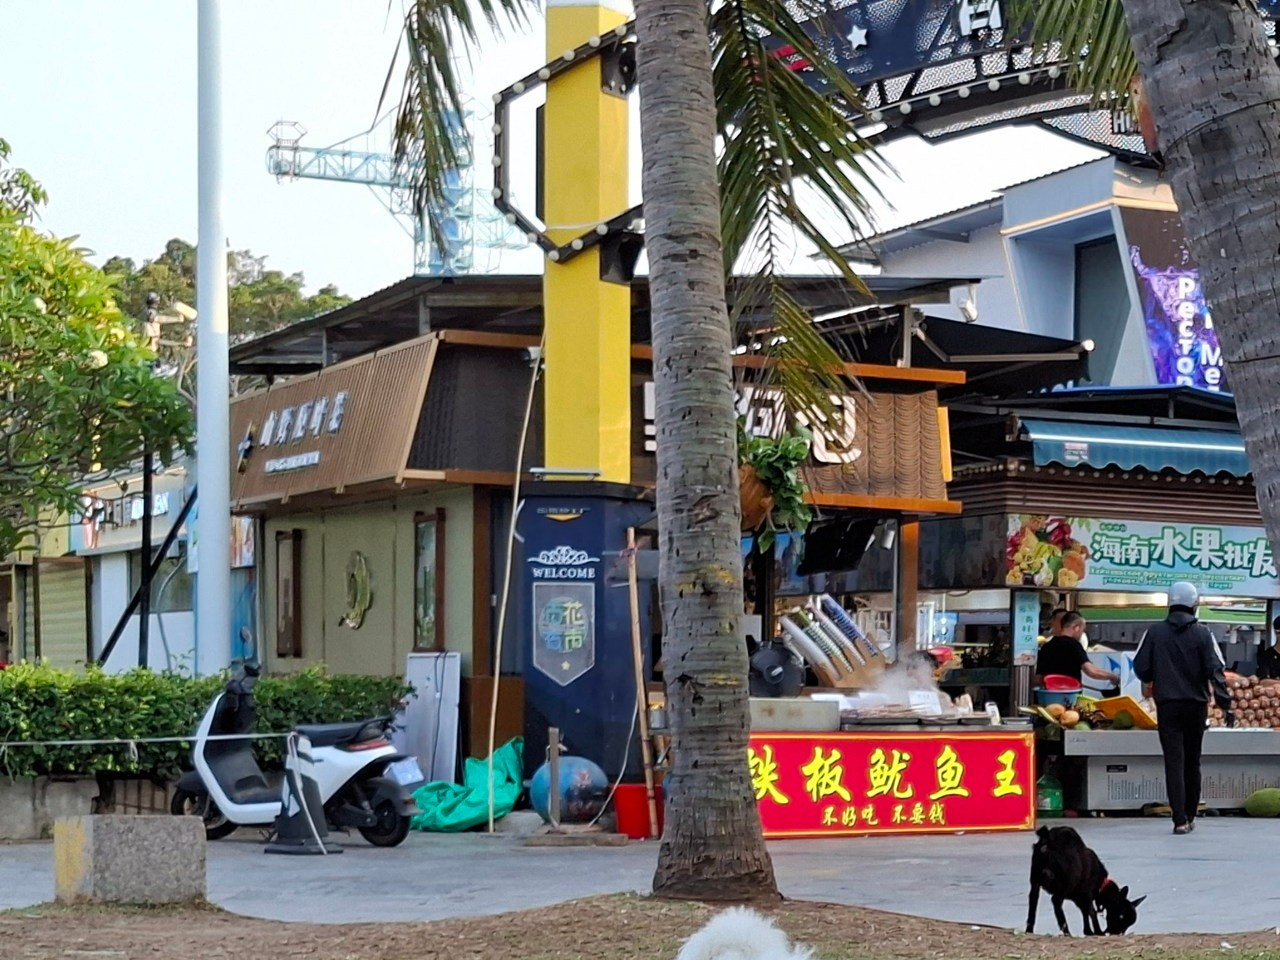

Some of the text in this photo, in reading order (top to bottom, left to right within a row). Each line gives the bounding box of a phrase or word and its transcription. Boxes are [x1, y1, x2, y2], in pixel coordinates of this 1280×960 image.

[1091, 526, 1279, 578] 海南水果批发
[532, 567, 596, 579] WELCOME
[748, 745, 1022, 804] 铁板鱿鱼王
[822, 803, 945, 828] 不好吃 不要钱
